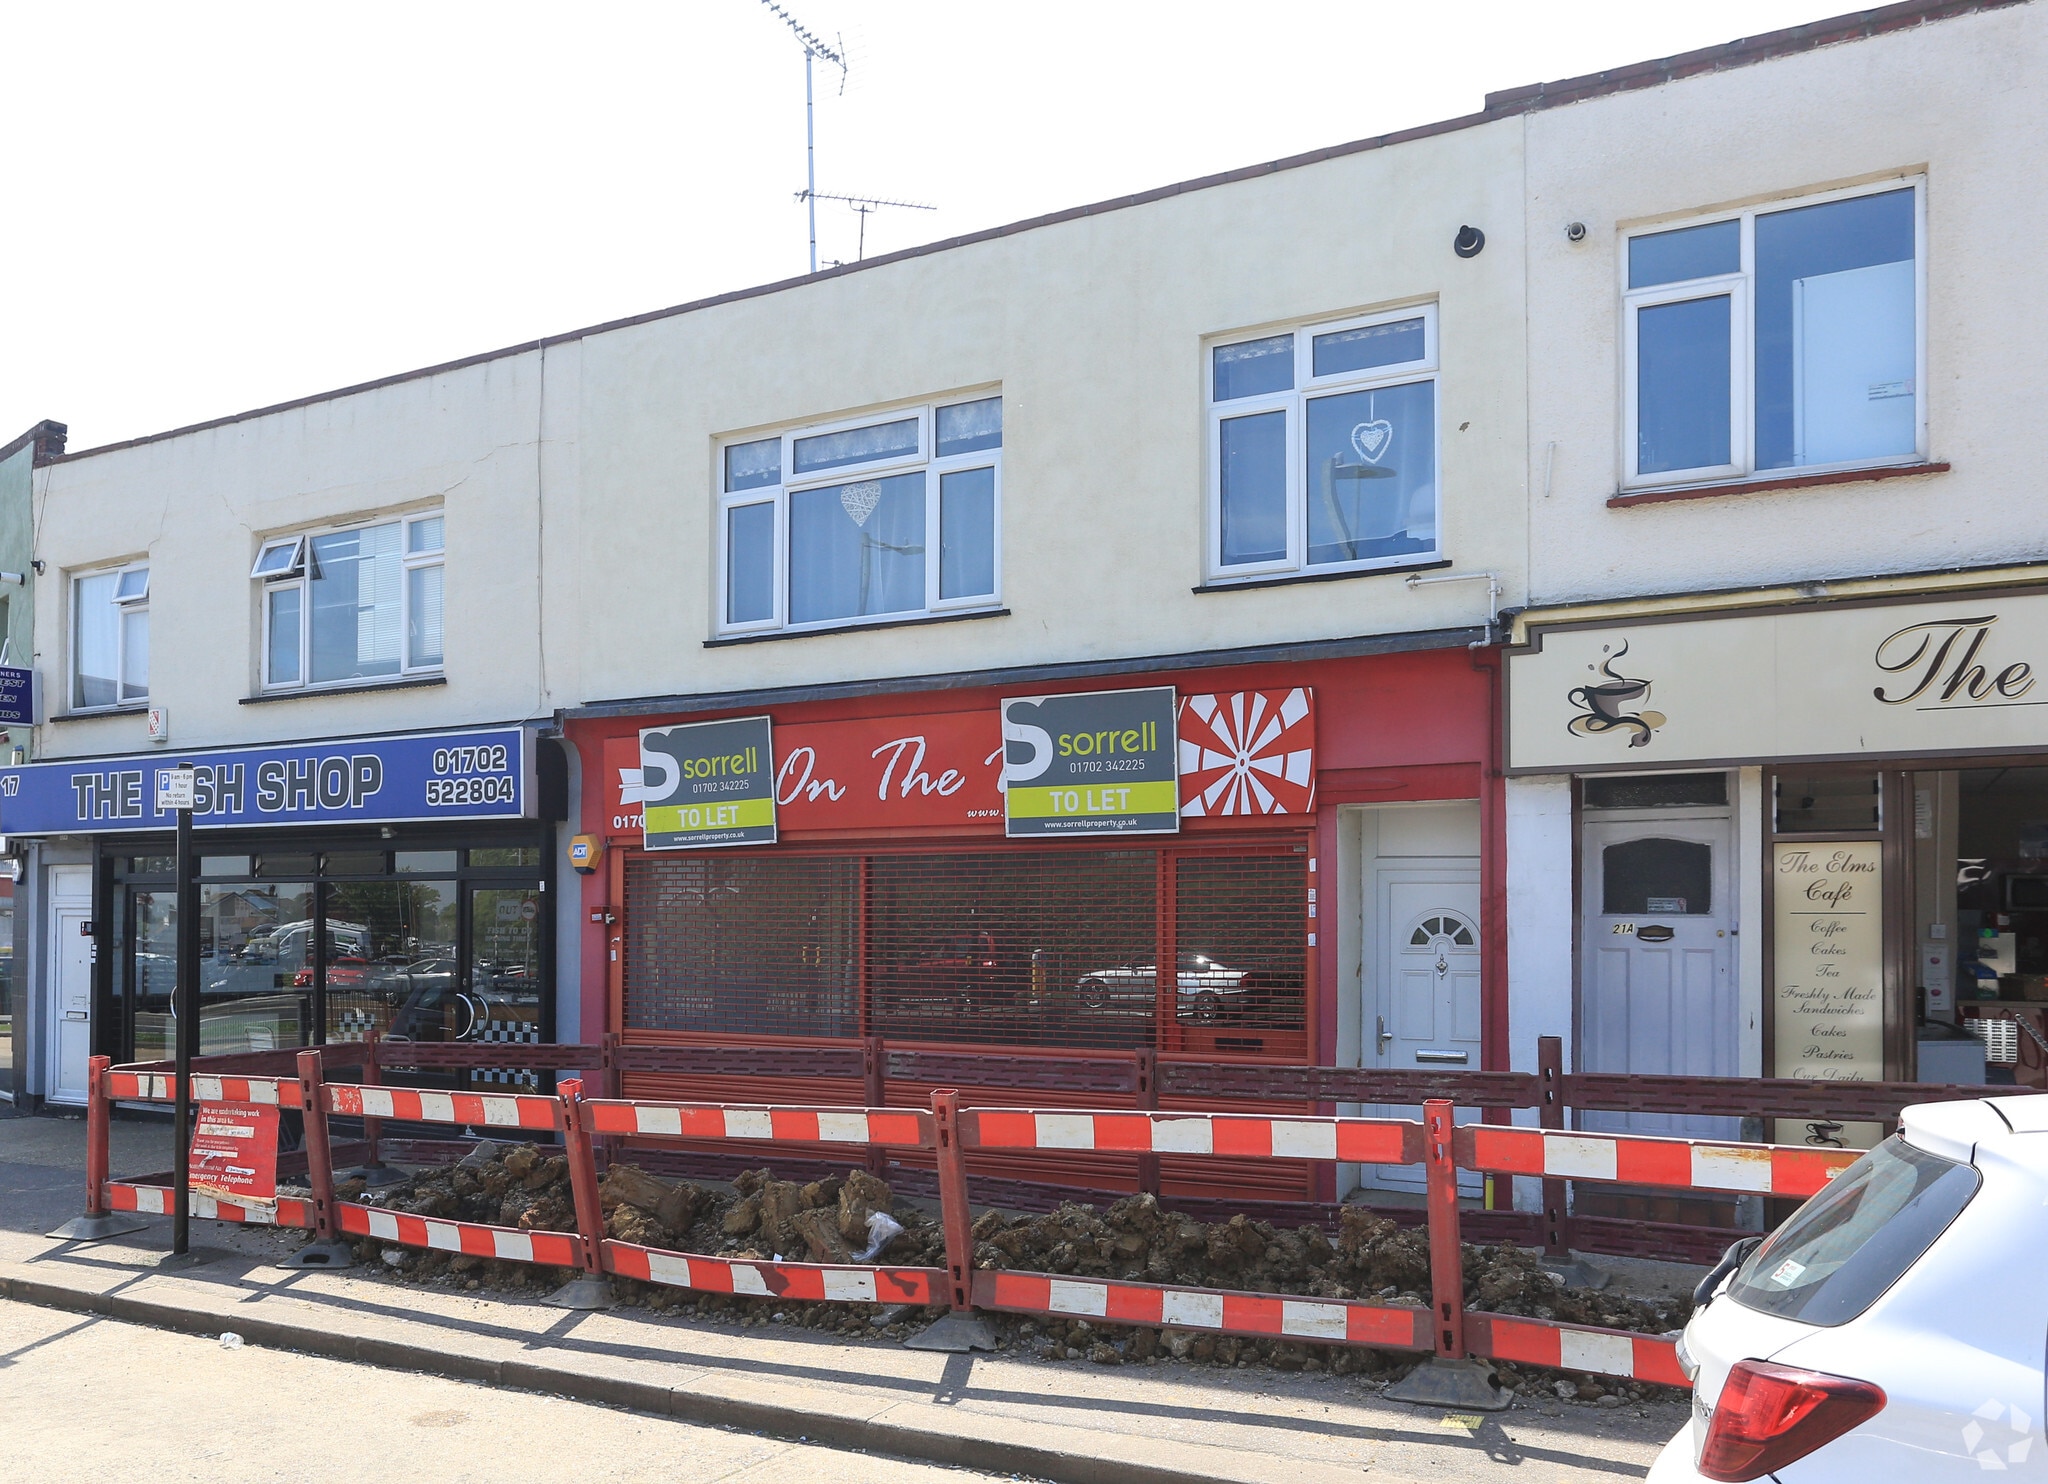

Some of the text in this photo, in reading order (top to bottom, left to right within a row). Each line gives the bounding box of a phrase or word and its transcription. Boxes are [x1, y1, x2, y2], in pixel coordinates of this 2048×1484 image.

[1873, 614, 2037, 706] The
[1058, 721, 1156, 757] sorrell
[432, 744, 507, 775] 01702
[683, 746, 757, 779] sorrell
[1069, 758, 1145, 774] 01702 342225
[775, 746, 846, 806] On
[871, 735, 966, 801] The
[0, 775, 20, 797] 17
[71, 770, 143, 820] THE
[257, 754, 383, 812] SHOP
[161, 774, 169, 790] P
[692, 779, 750, 793] 01702 342225
[426, 776, 514, 807] 522804
[1049, 788, 1131, 813] TO LET
[677, 805, 740, 828] TO LET
[1044, 818, 1138, 830] www.sorrellproperty.co.uk
[673, 831, 745, 842] www.sorrellproperty.co.uk
[573, 846, 587, 856] ADT
[1780, 851, 1876, 873] The Elms
[1802, 878, 1853, 909] Café
[1612, 923, 1634, 934] 21A
[1809, 918, 1847, 937] Coffee
[1810, 941, 1847, 955] Cakes
[1815, 963, 1840, 977] Tea
[1781, 985, 1877, 1004] Freshly Made
[1793, 1000, 1865, 1015] Sandwiches
[1810, 1023, 1847, 1037] Cakes
[1802, 1044, 1854, 1060] Pastries
[247, 1109, 260, 1117] work
[220, 1174, 254, 1185] Telephone
